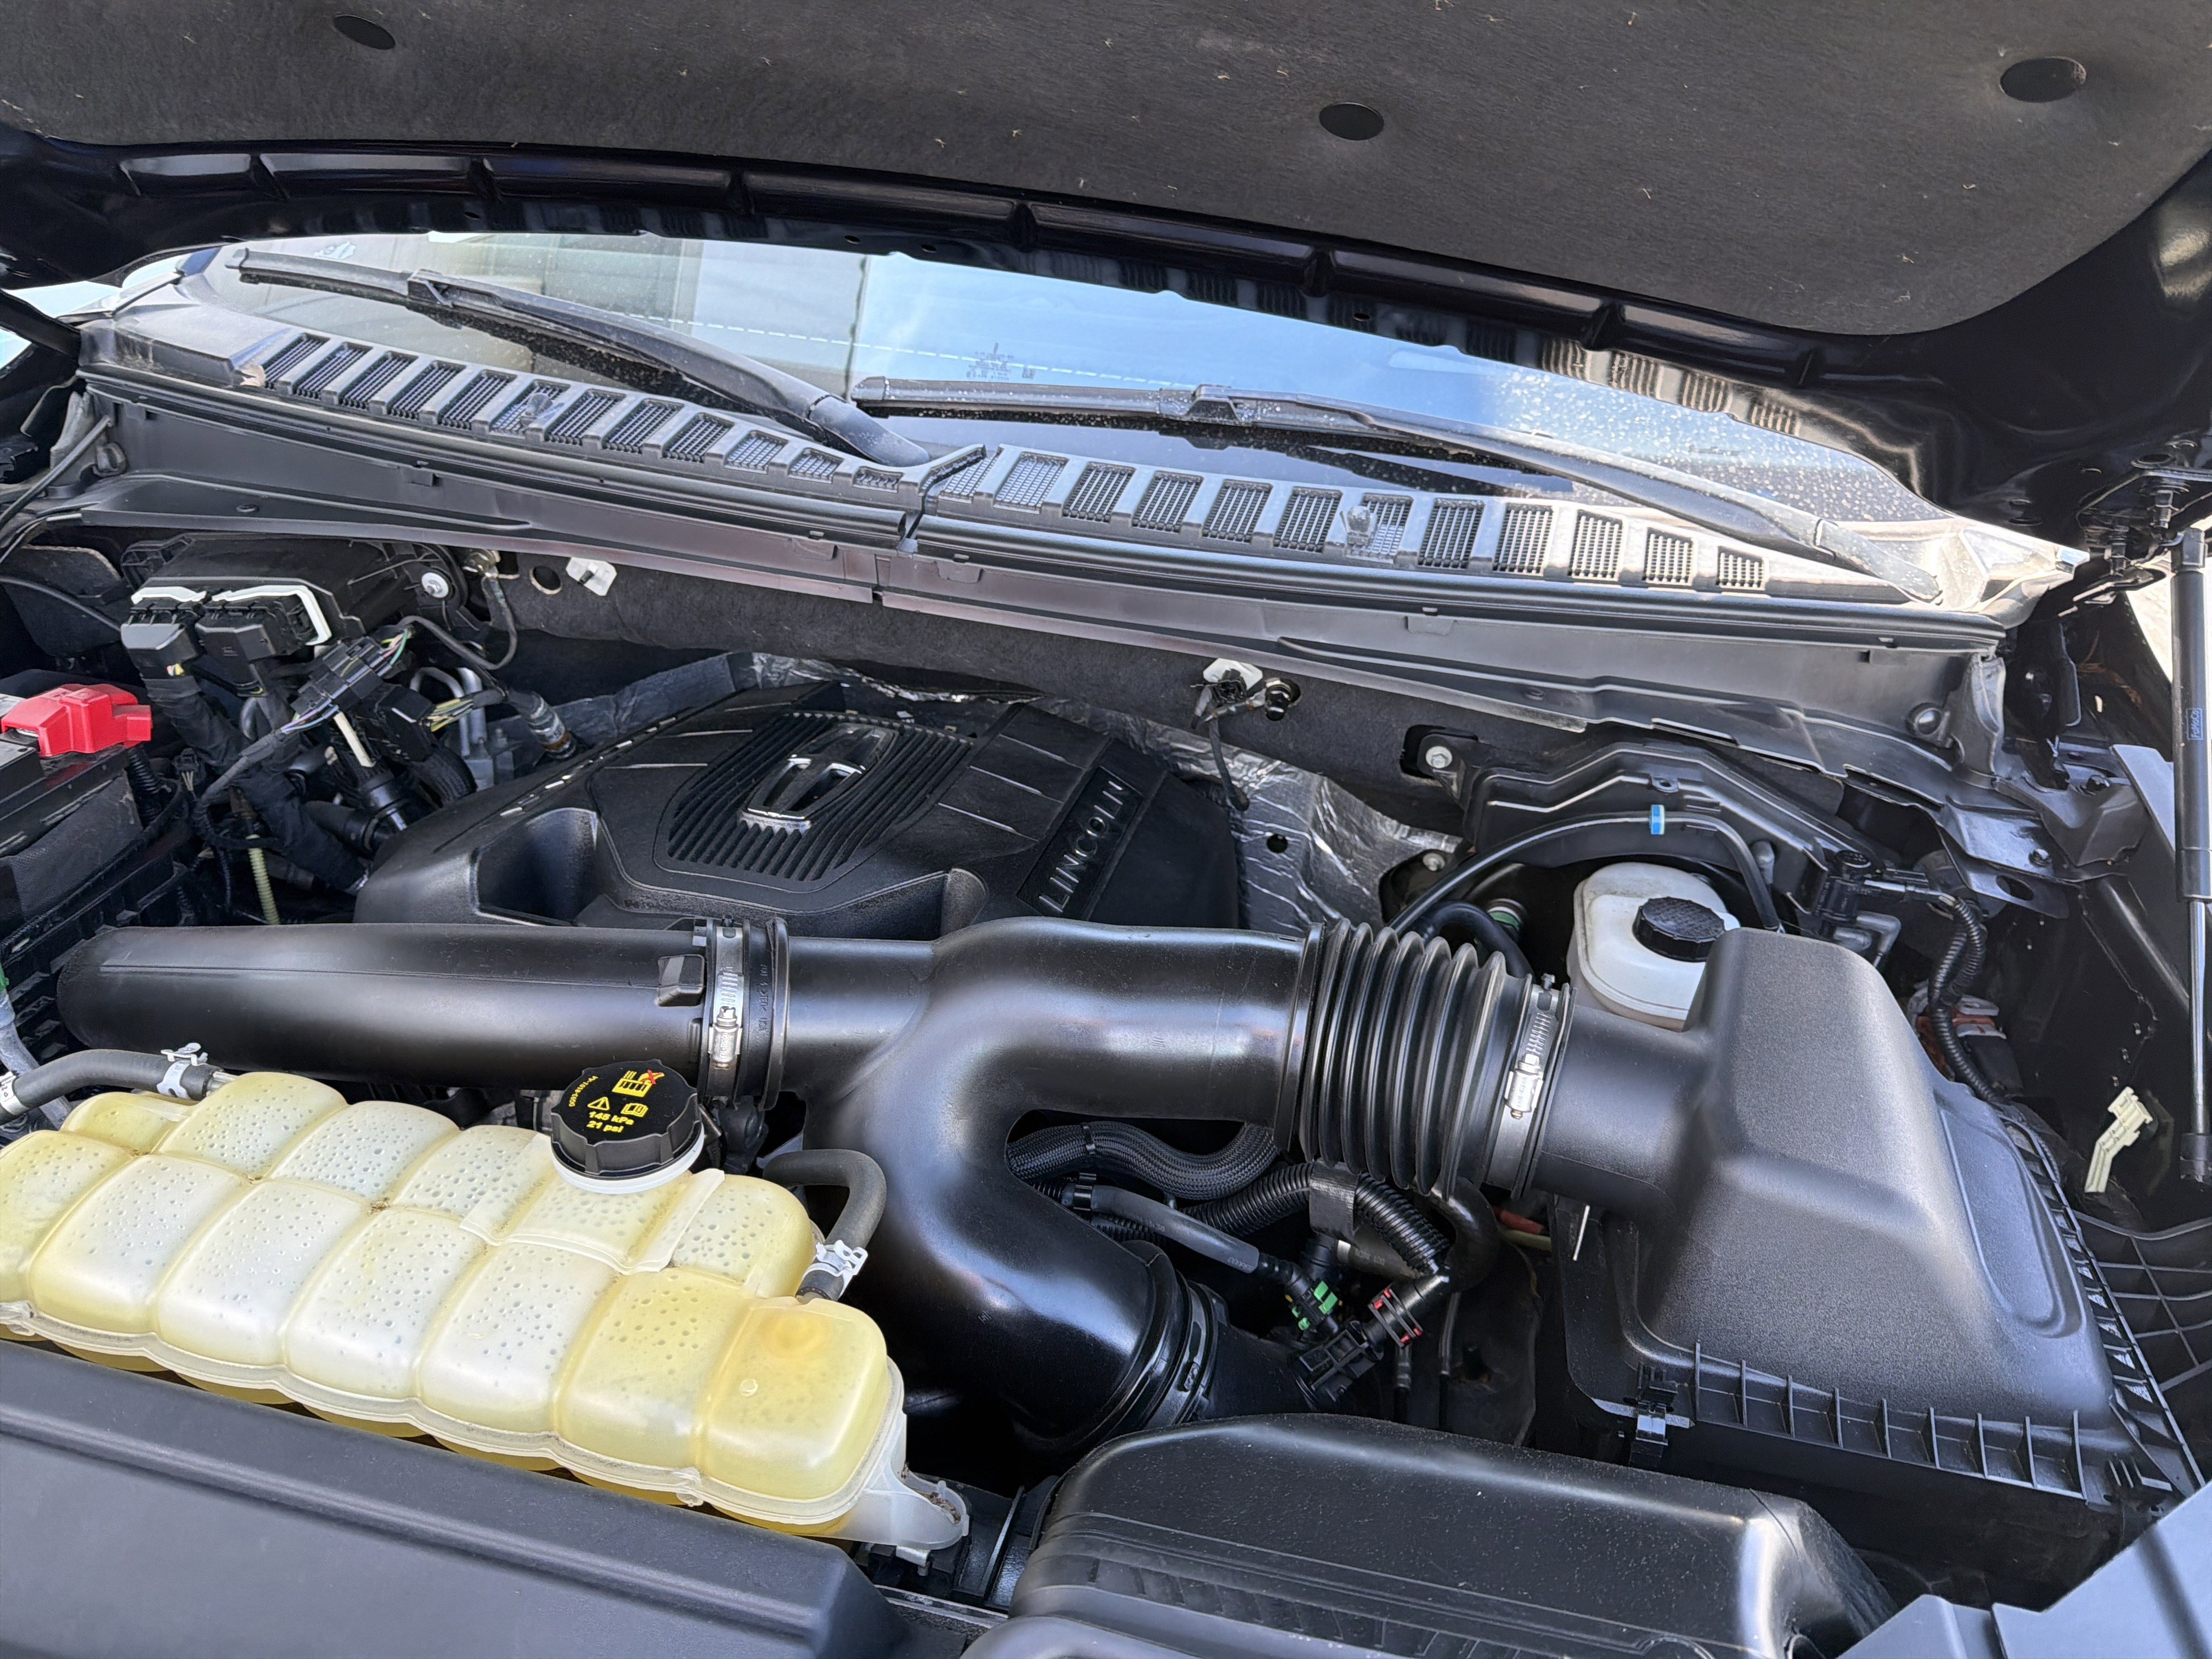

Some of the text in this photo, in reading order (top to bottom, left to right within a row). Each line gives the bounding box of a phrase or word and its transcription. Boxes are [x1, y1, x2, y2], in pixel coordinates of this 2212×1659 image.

[1038, 780, 1130, 913] LINCOLN
[589, 1111, 634, 1125] 145 kPa
[586, 1120, 624, 1133] 21 psi
